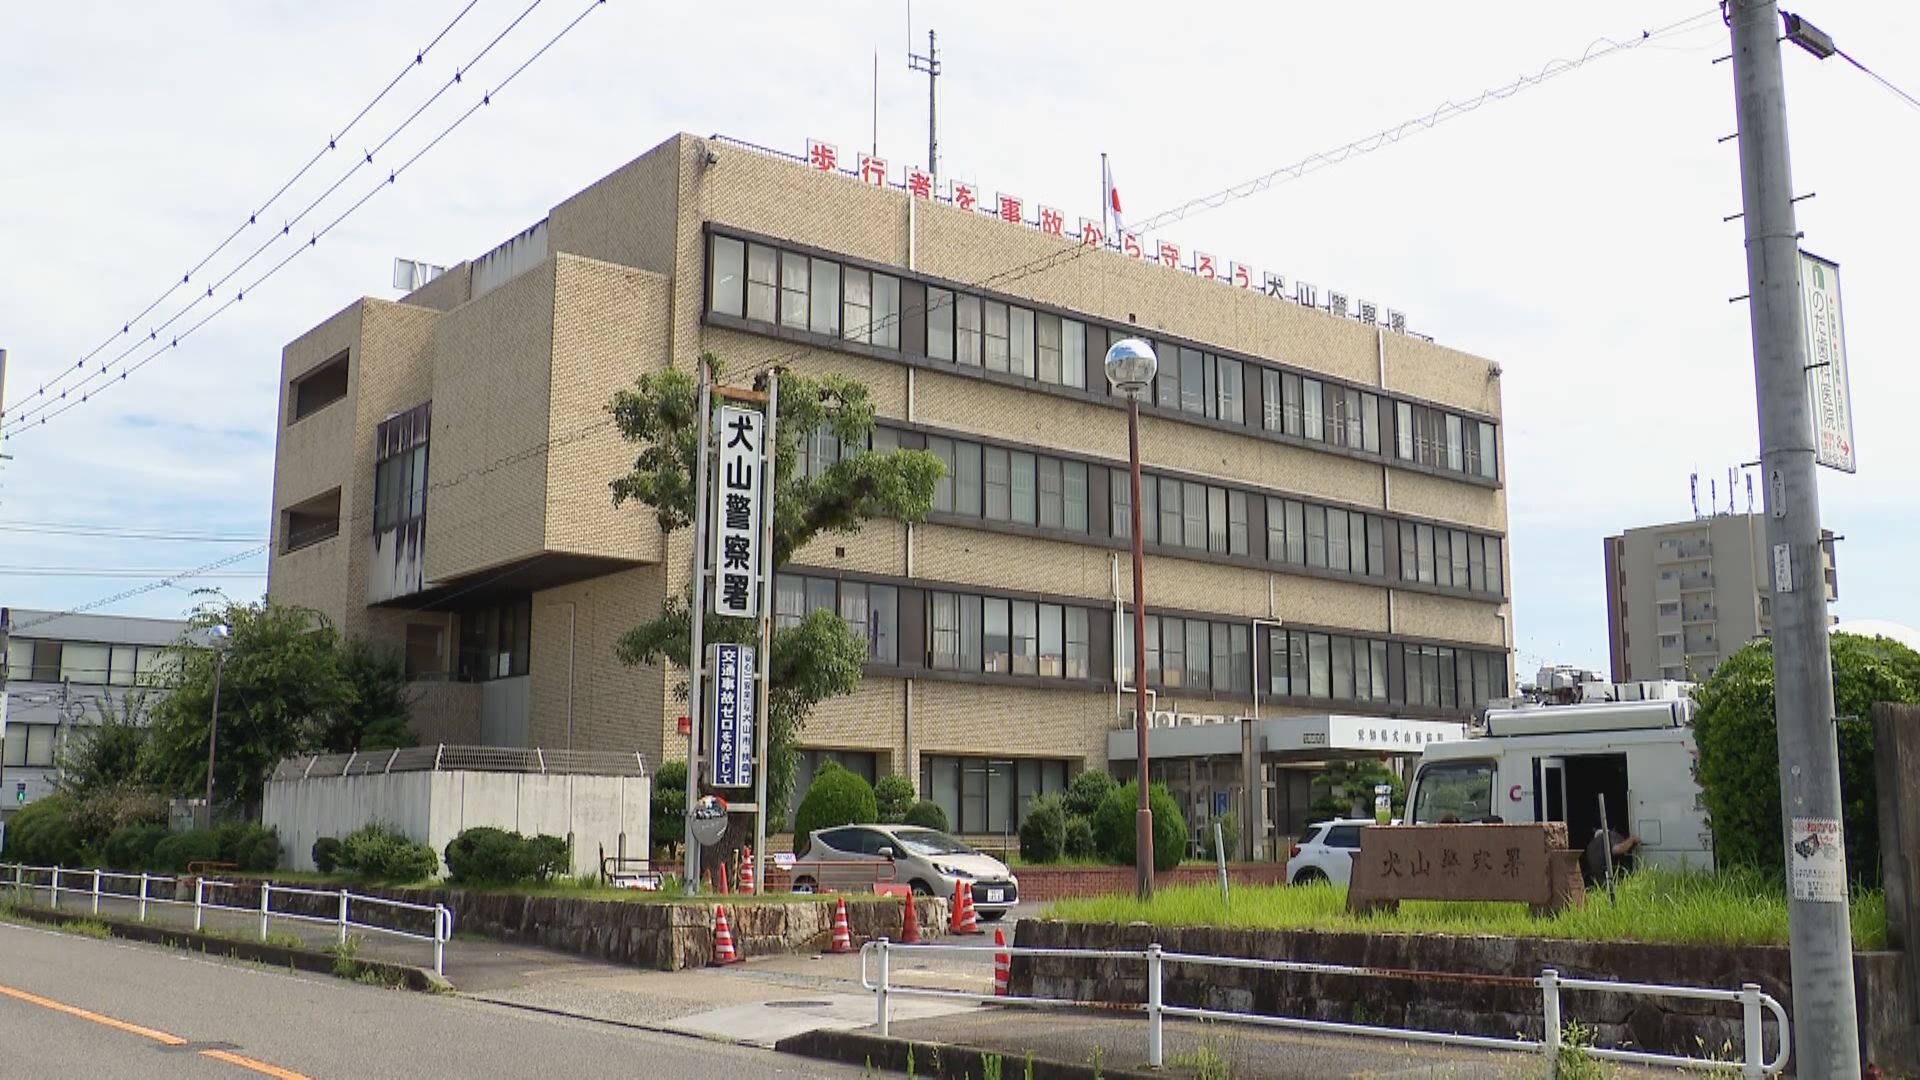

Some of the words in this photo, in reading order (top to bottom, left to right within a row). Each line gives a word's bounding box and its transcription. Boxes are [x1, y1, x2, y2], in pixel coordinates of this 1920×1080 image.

[723, 415, 754, 610] 犬山警察署
[720, 648, 737, 784] 交通事故ゼロをめざして
